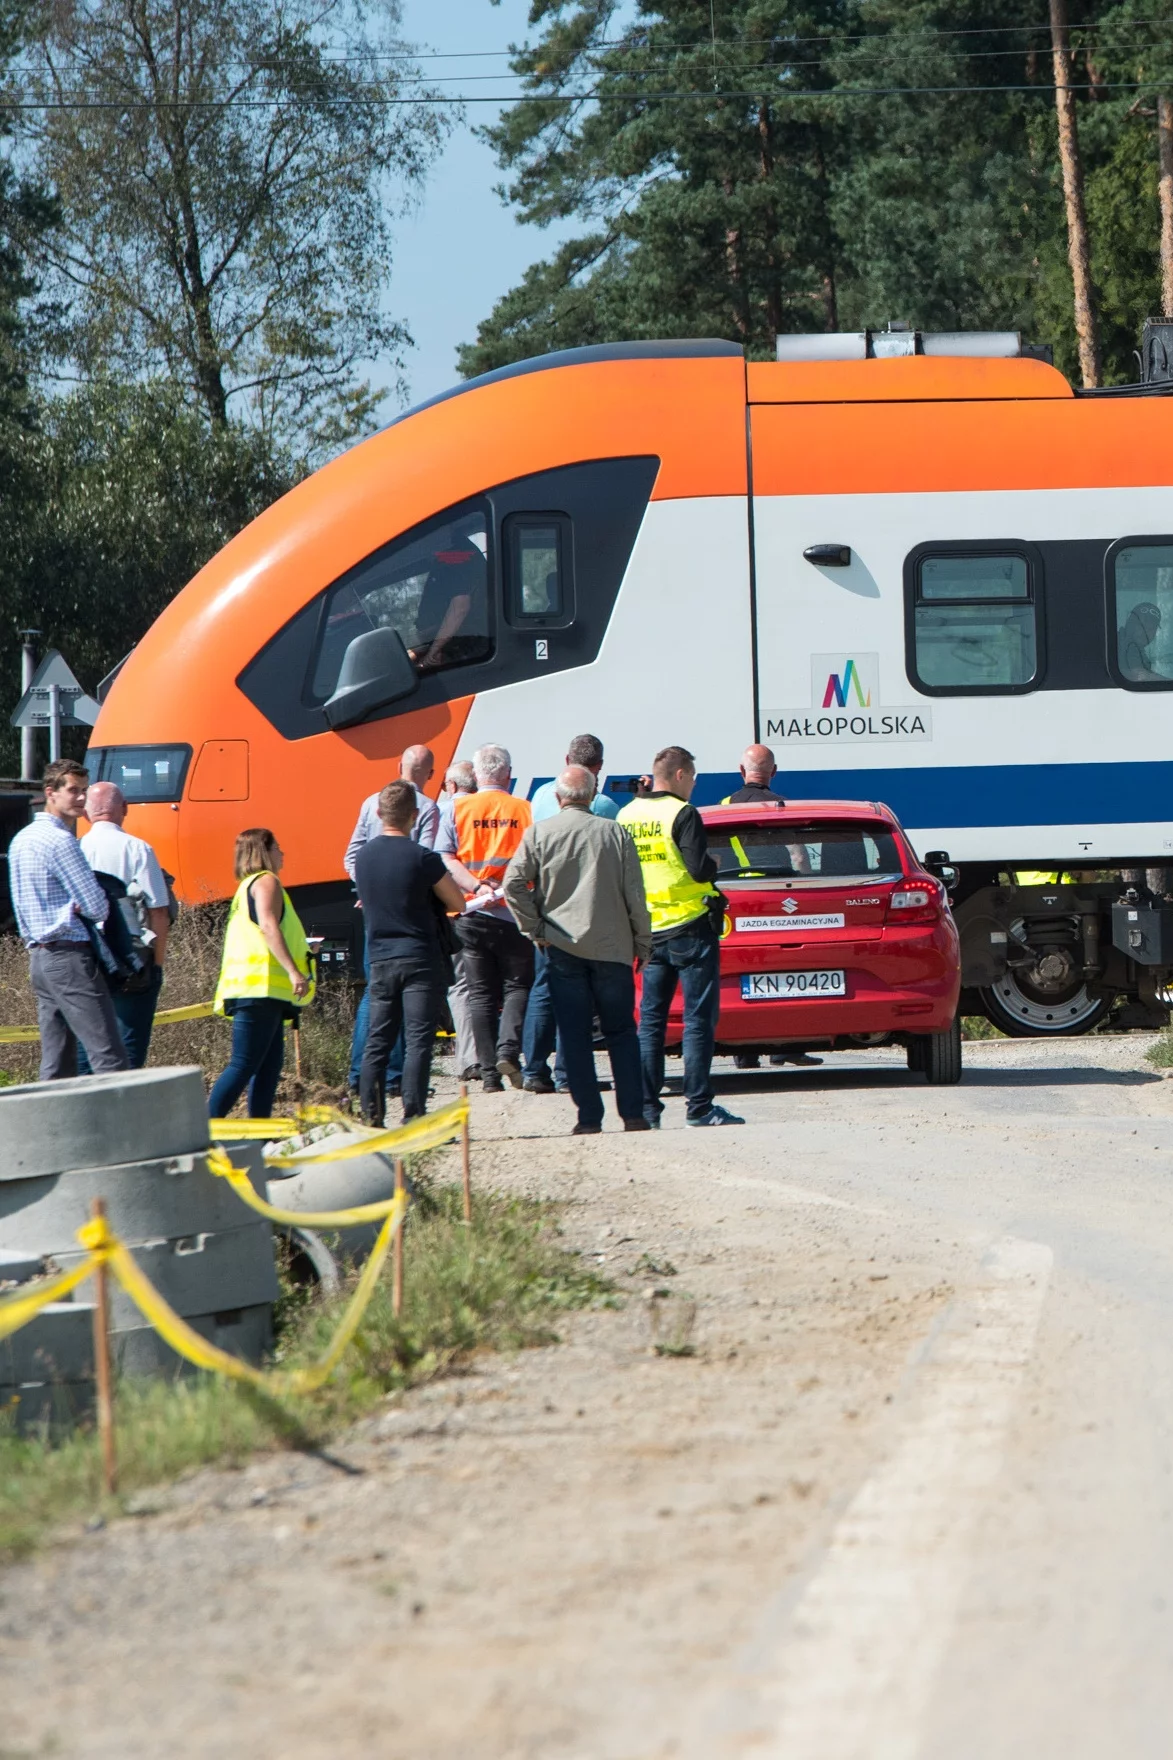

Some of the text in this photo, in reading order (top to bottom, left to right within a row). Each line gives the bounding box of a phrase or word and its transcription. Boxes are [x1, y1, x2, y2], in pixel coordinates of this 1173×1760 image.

[537, 641, 547, 656] 2
[767, 716, 926, 737] MAŁOPOLSKA
[741, 917, 840, 928] JAZDA EGZAMINACYJNA
[752, 972, 841, 993] KN 90420
